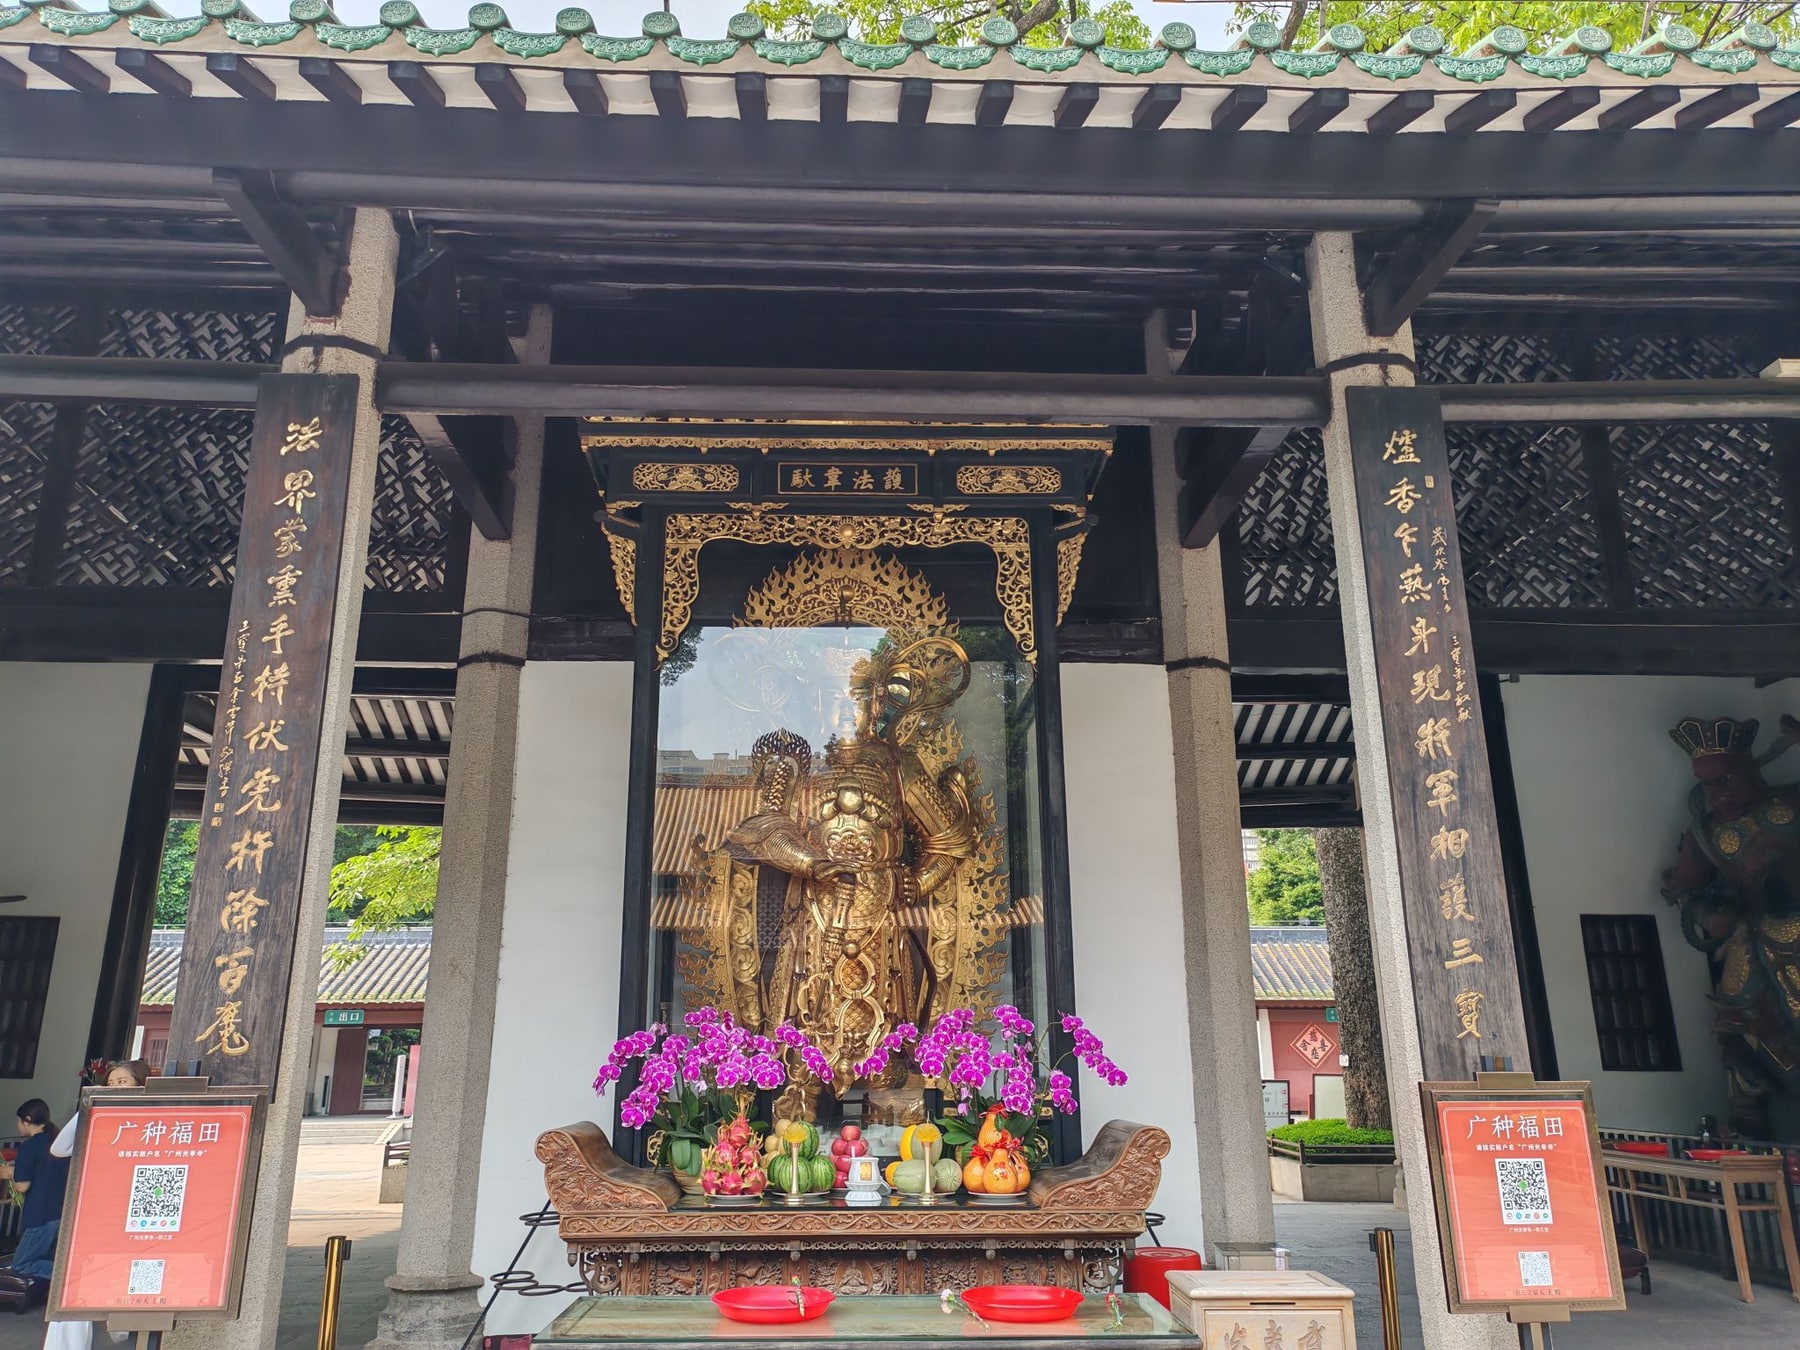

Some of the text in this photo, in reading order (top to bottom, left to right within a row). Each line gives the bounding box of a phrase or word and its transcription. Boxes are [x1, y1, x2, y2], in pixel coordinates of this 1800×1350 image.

[339, 1011, 359, 1022] 出口
[111, 1120, 221, 1146] 广种福田
[1466, 1114, 1563, 1140] 广种福田
